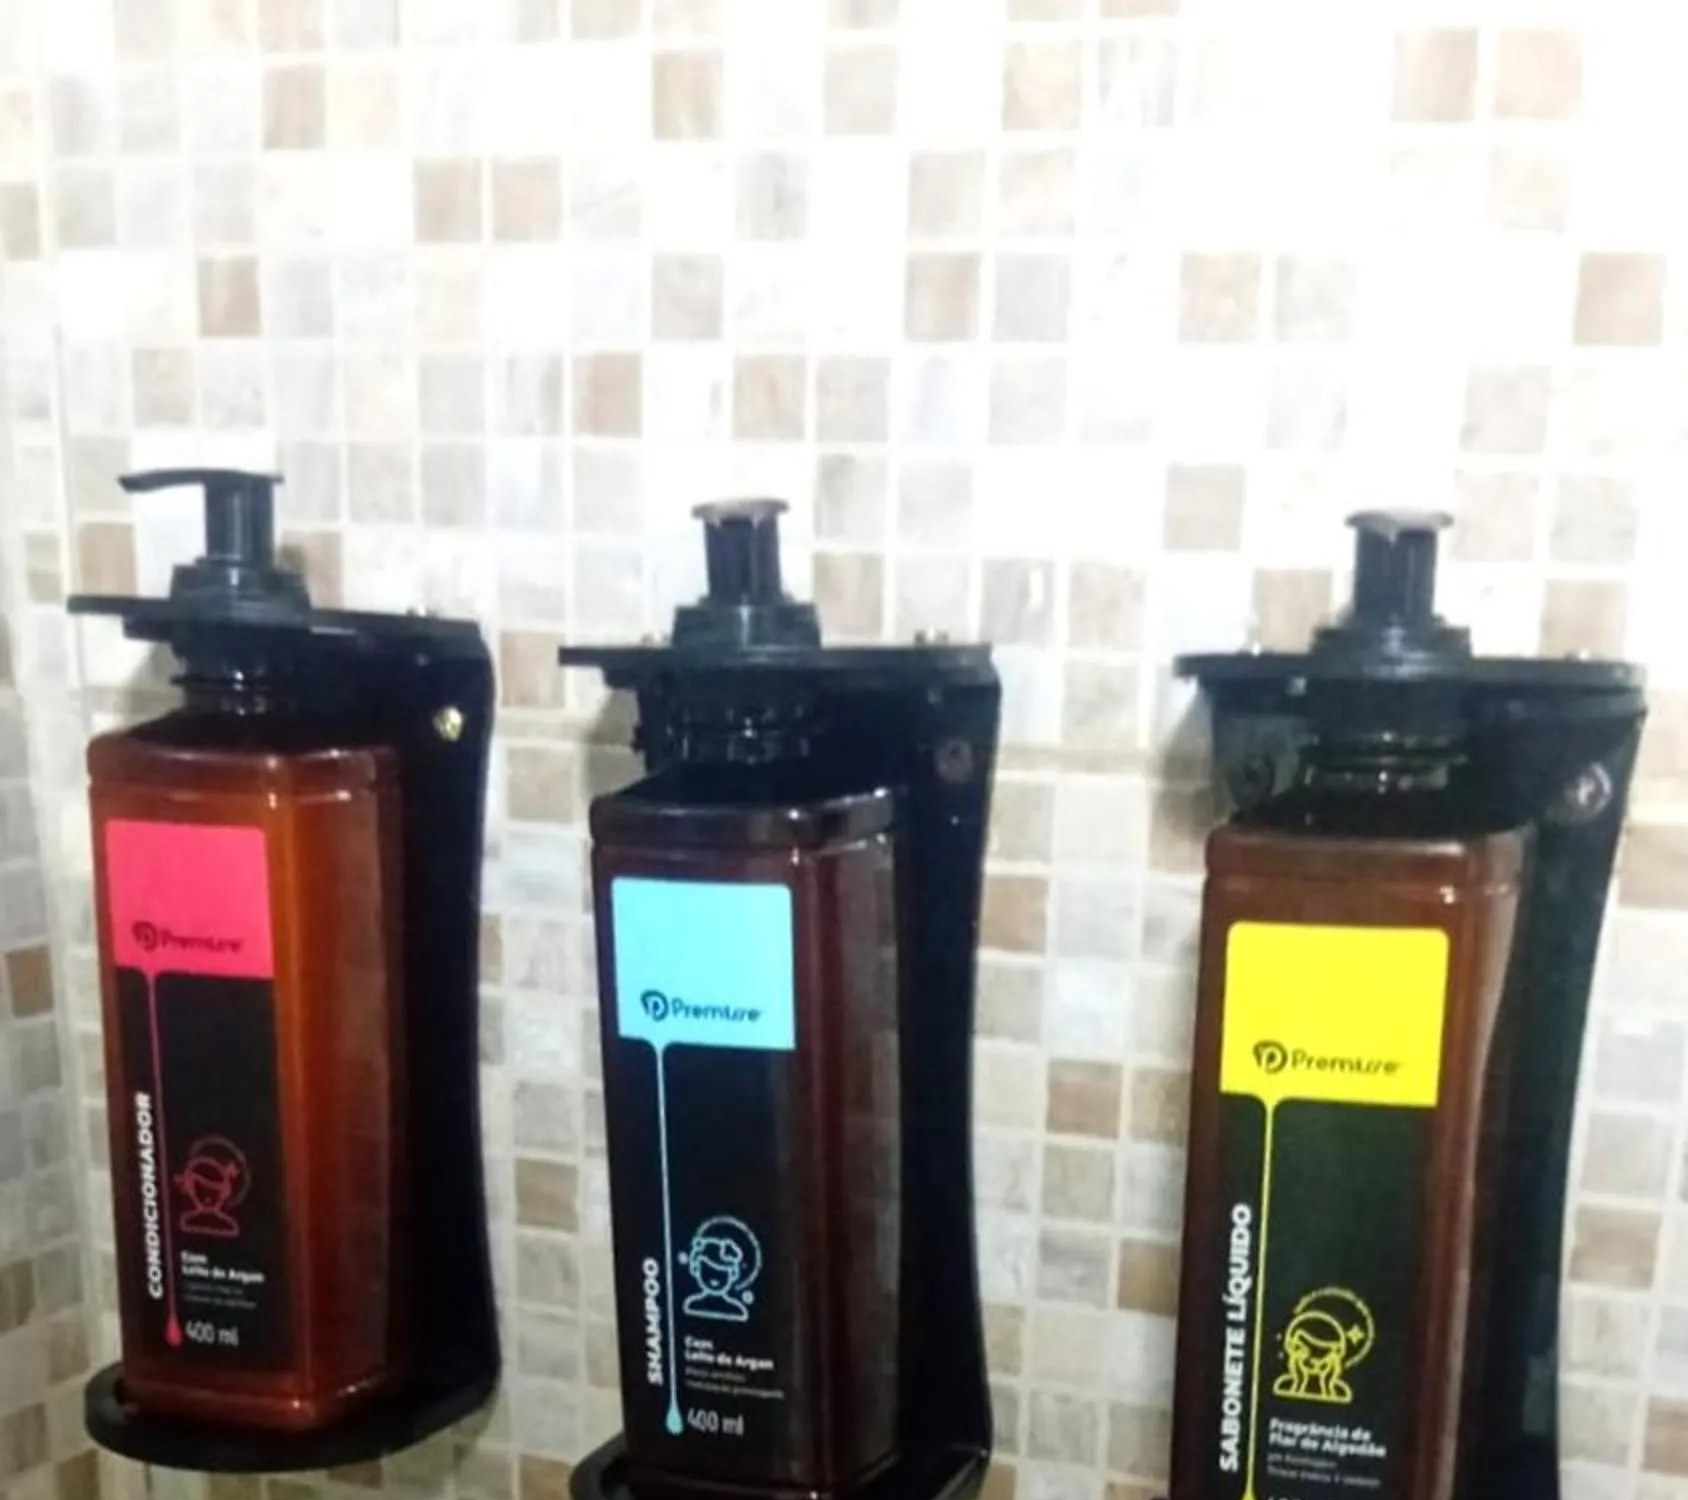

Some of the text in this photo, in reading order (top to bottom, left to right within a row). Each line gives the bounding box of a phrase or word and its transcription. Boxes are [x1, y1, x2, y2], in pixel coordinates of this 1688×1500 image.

[135, 1091, 163, 1299] CONDICIONADOR
[185, 1320, 239, 1347] 400 ml
[642, 1257, 663, 1386] SHAMPOO
[1219, 1202, 1252, 1472] SABONETE LÍQUIDO
[687, 1408, 744, 1436] 400 ml
